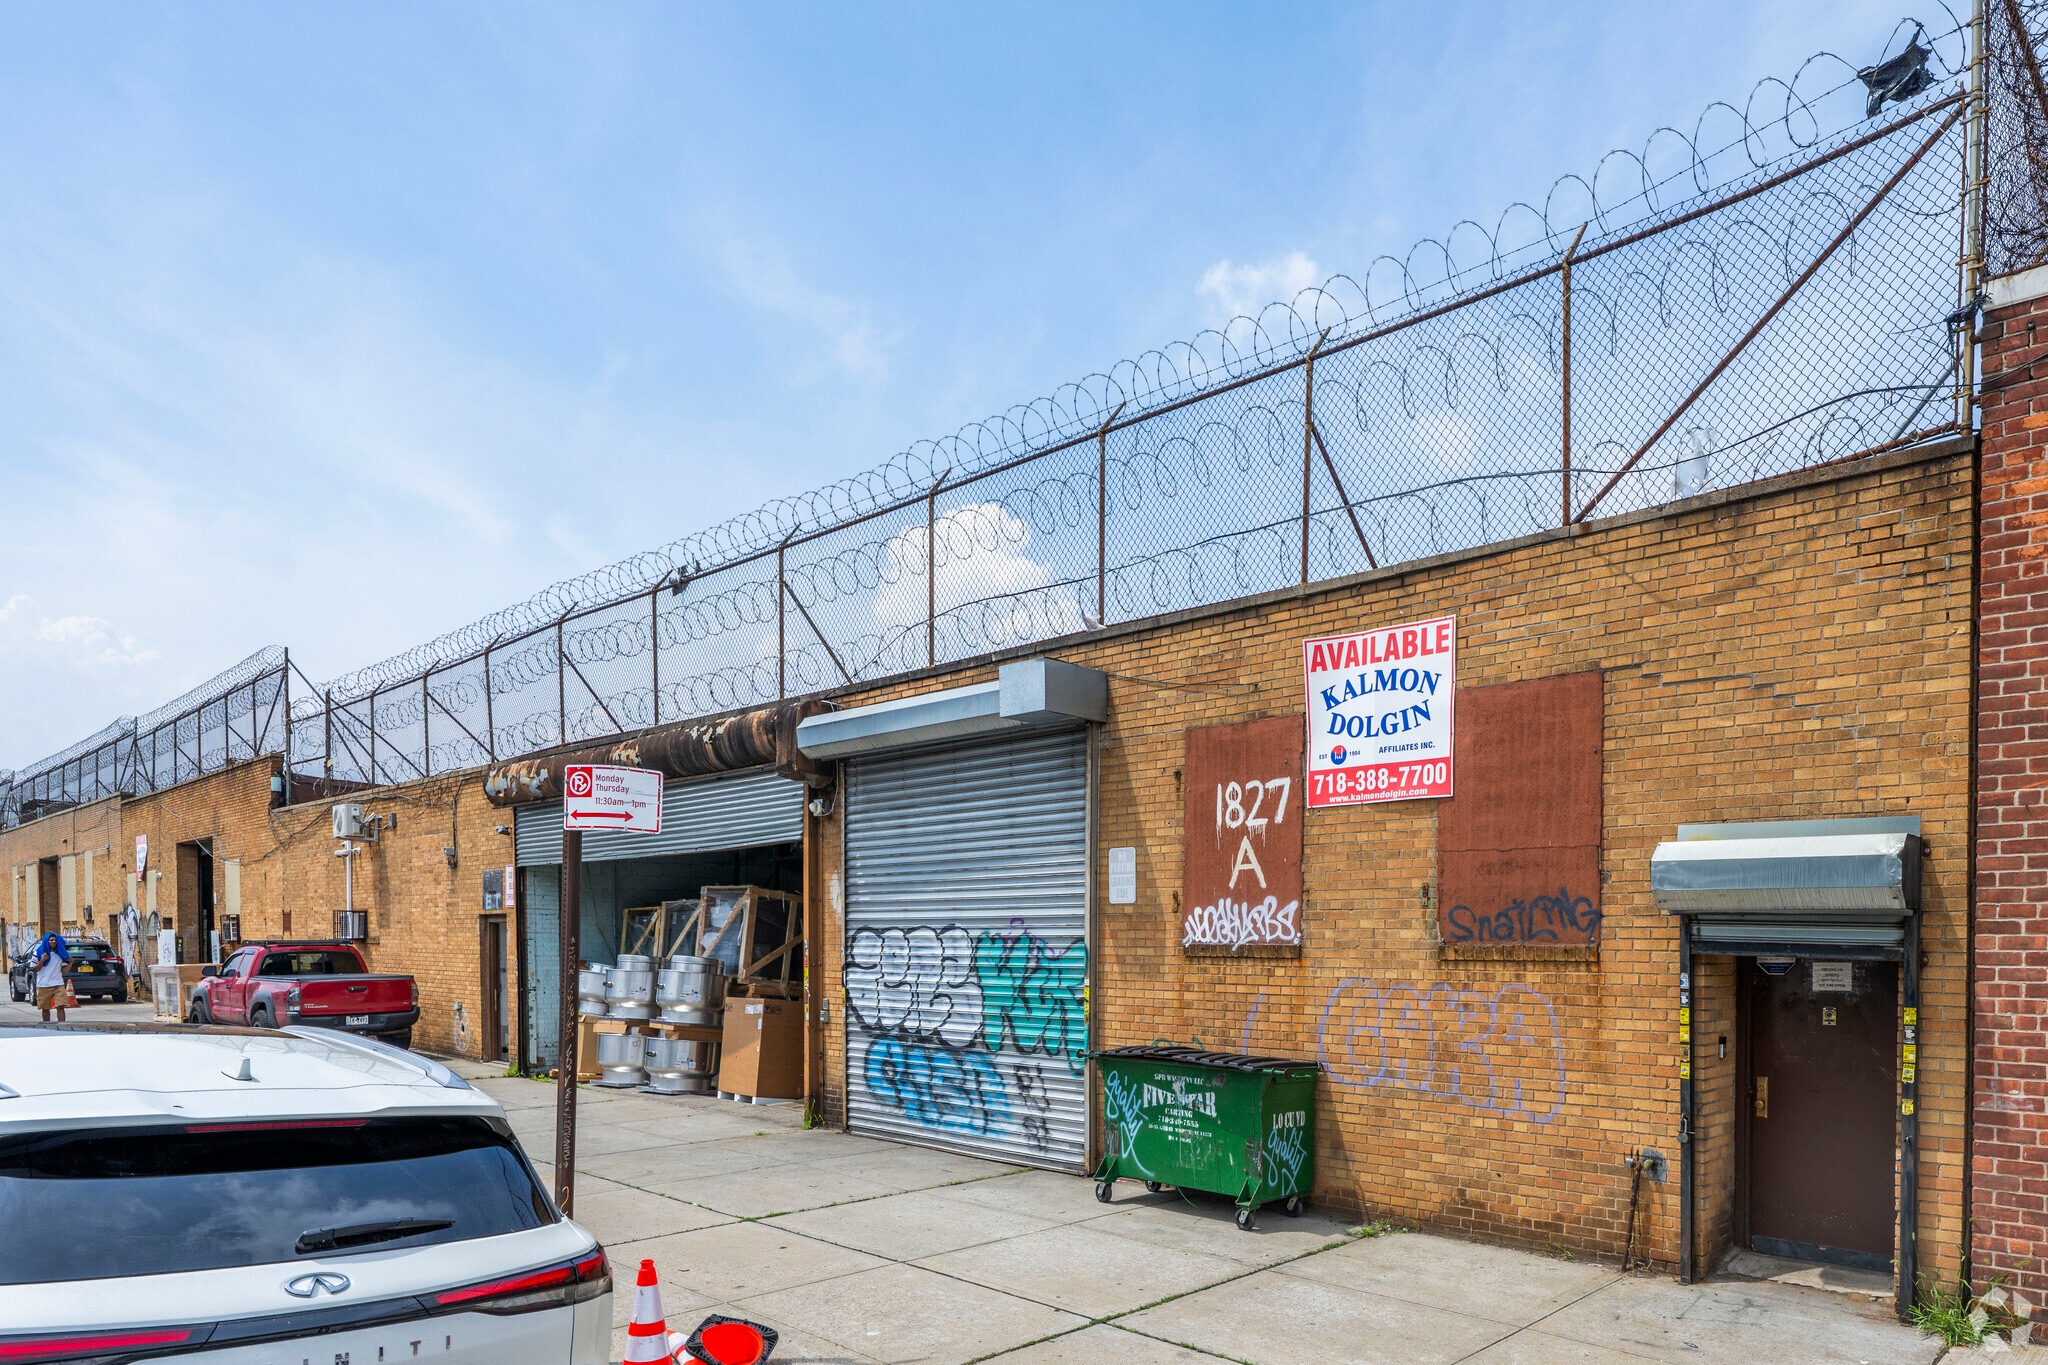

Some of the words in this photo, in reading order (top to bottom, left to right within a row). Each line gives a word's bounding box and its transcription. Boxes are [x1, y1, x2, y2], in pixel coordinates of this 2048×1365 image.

[1311, 623, 1450, 673] AVAILABLE
[1320, 668, 1442, 711] KALMON
[1327, 699, 1432, 738] DOLGIN
[1378, 744, 1419, 754] AFFILIATES
[1420, 742, 1436, 750] INC.
[595, 774, 624, 784] Monday
[595, 784, 630, 794] Thursday
[1314, 762, 1447, 795] 718-388-7700
[595, 797, 624, 806] 11:30am
[632, 799, 647, 808] 1pm
[1216, 776, 1291, 829] 1827
[1329, 788, 1428, 803] www.kalmondolgin.com
[1228, 835, 1267, 890] A
[1111, 876, 1134, 887] LOADING
[1143, 1083, 1176, 1108] FIVE
[1284, 1111, 1295, 1128] CU
[1296, 1110, 1306, 1126] YD
